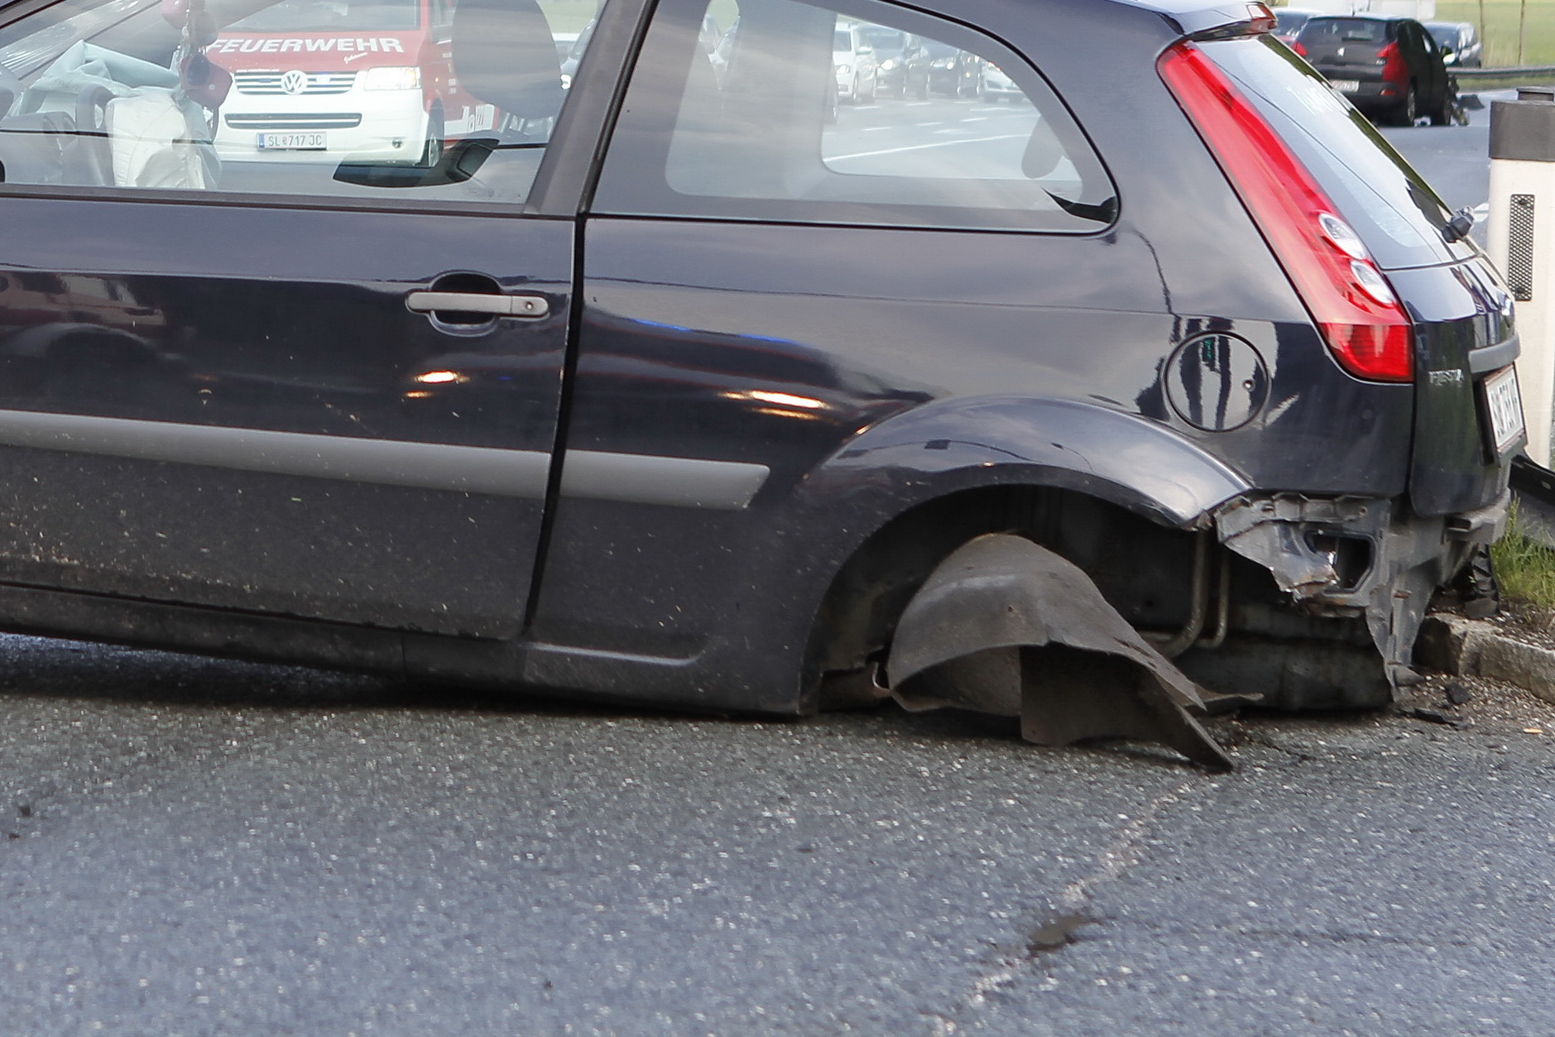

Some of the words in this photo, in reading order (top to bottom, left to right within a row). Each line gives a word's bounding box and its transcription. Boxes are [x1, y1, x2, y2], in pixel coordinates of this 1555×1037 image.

[206, 38, 405, 54] FEUERWEHR
[268, 135, 281, 147] SL
[288, 135, 306, 147] 717
